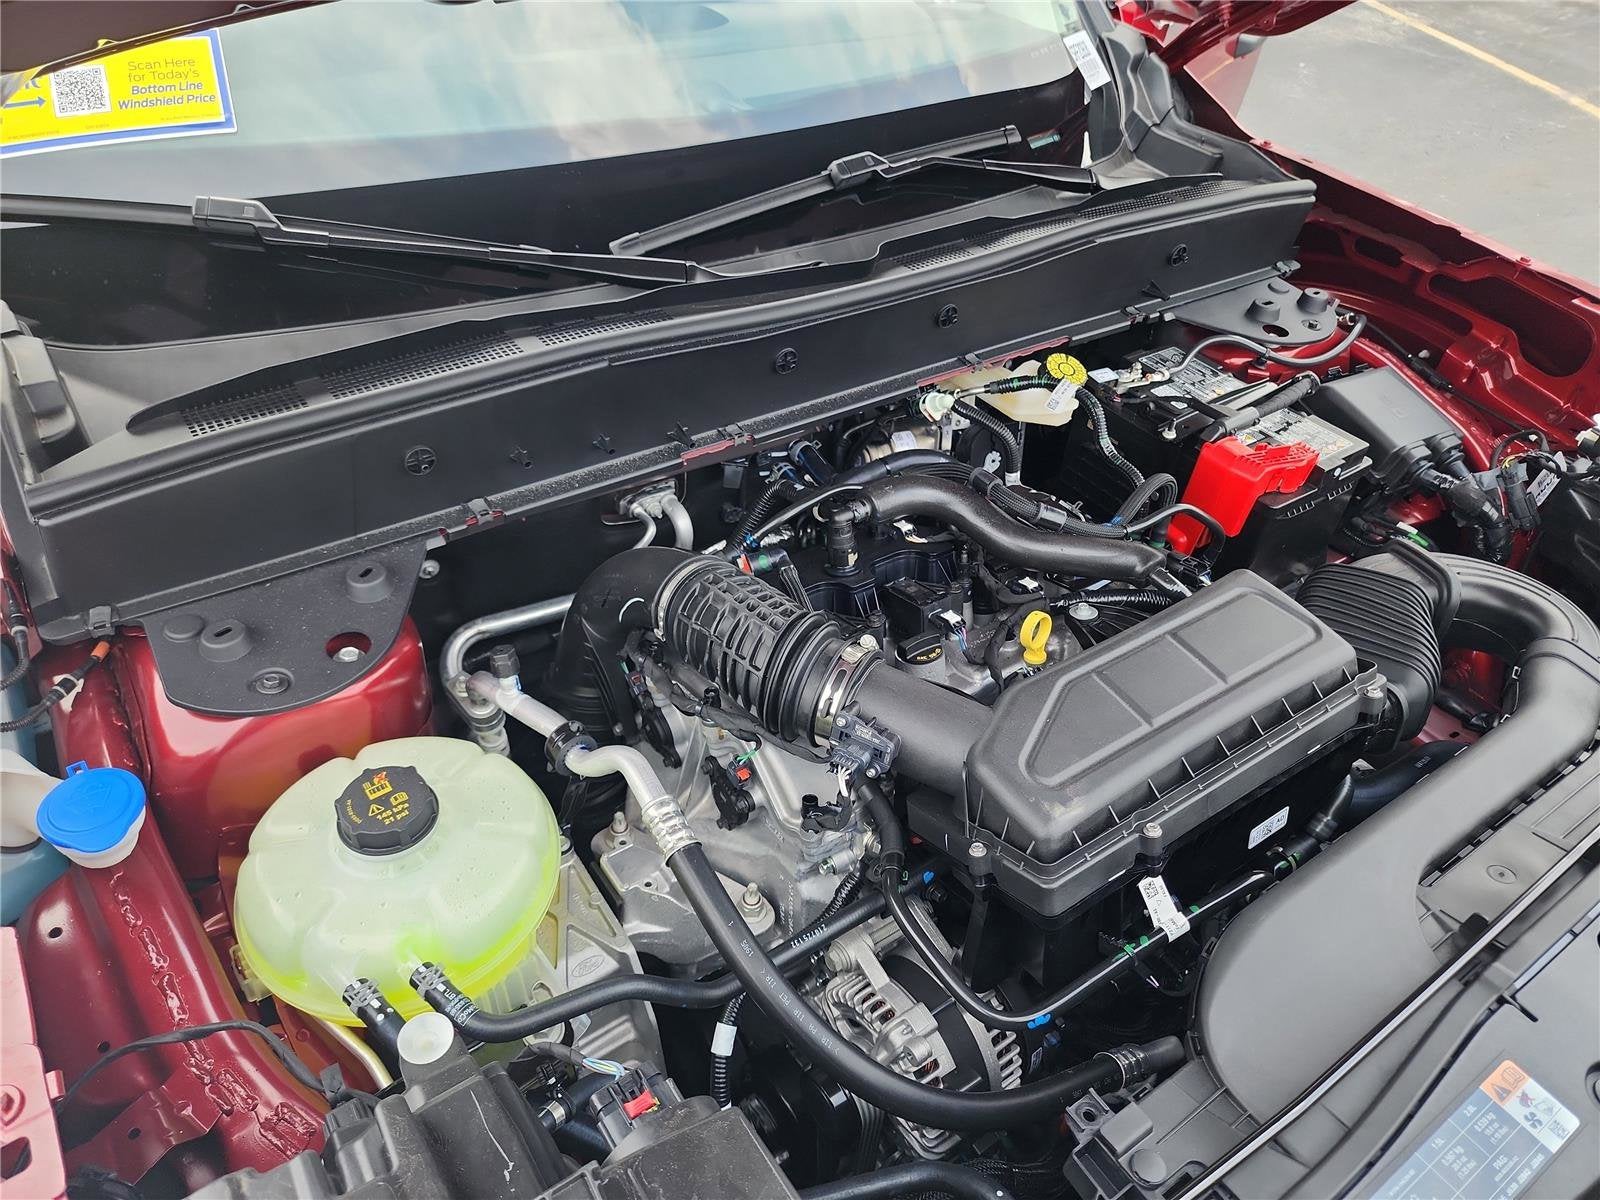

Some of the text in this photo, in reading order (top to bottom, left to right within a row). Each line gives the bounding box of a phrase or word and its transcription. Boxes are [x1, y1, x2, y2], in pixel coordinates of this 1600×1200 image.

[128, 58, 196, 71] Scan Here
[128, 68, 200, 83] for Today's
[131, 80, 203, 95] Bottom Line
[118, 93, 216, 110] Windshield Price
